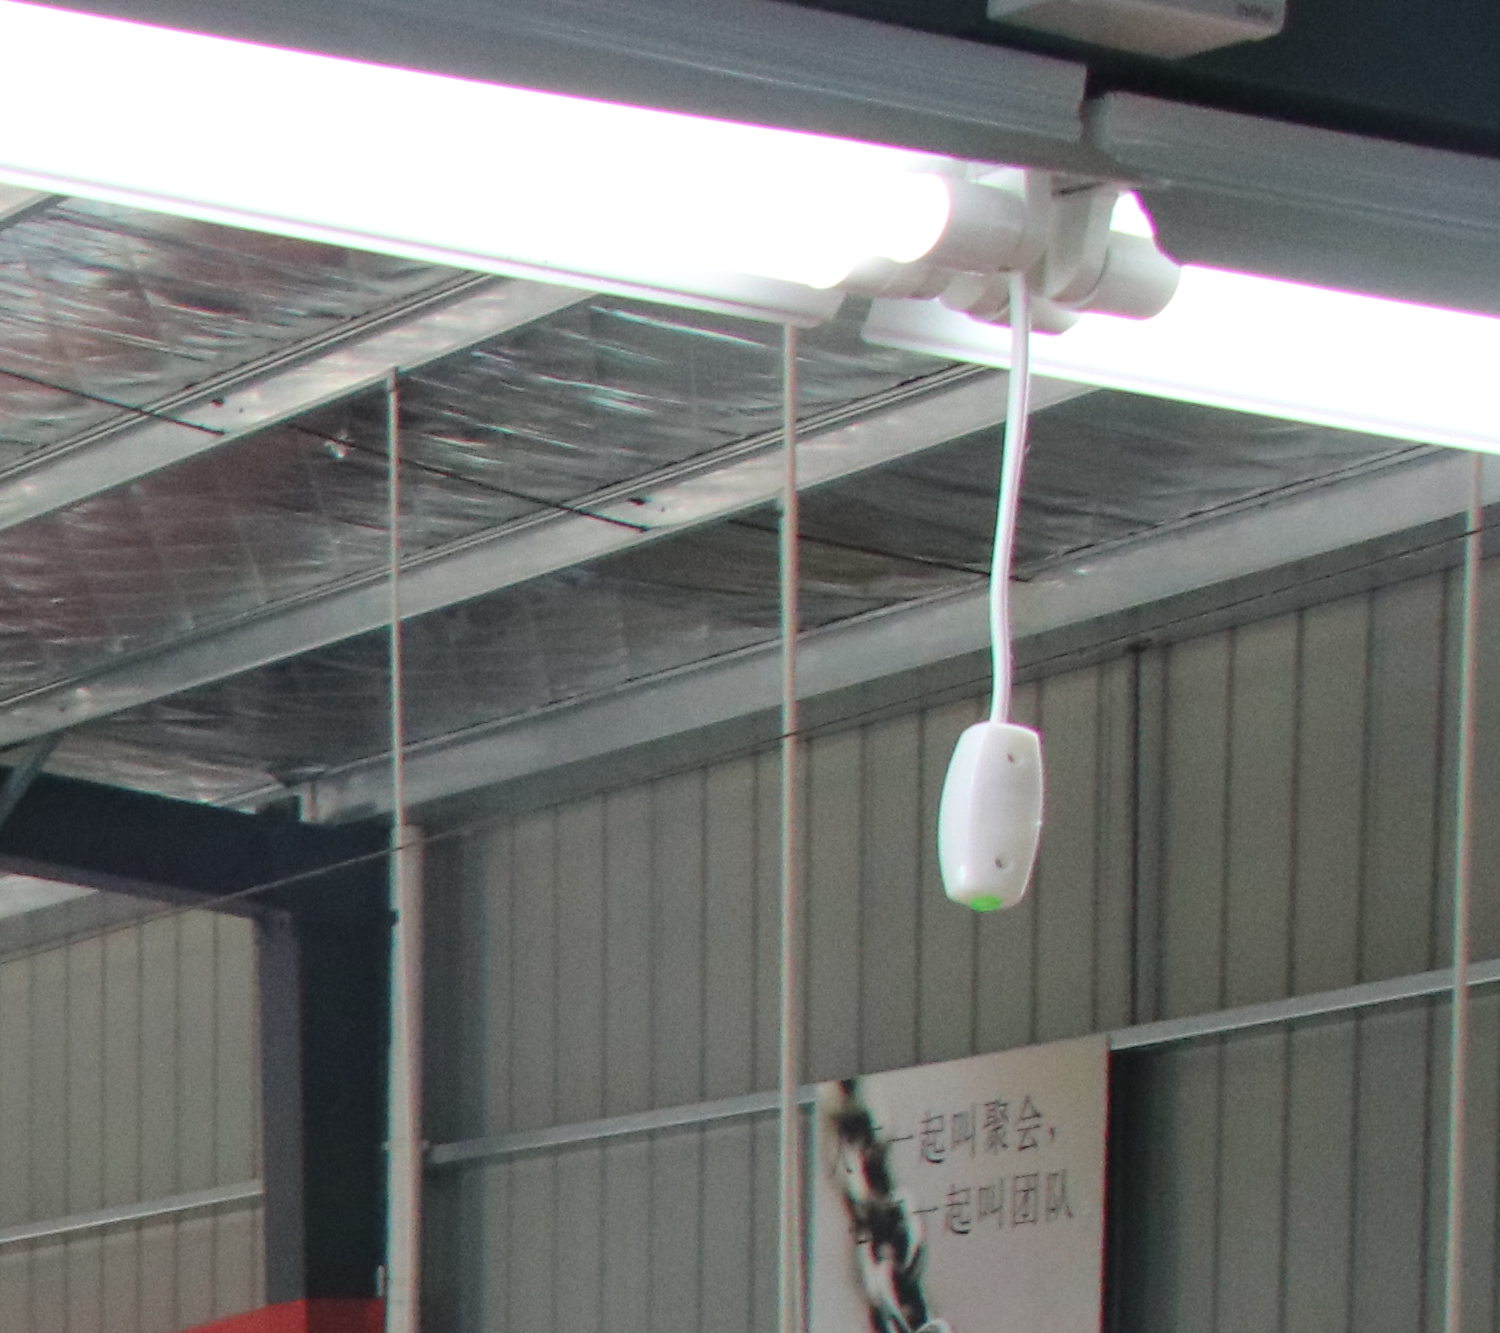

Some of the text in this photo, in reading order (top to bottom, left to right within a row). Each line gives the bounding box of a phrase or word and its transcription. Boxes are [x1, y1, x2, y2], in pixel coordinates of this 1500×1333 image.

[912, 1169, 1074, 1235] 一起叫团队
